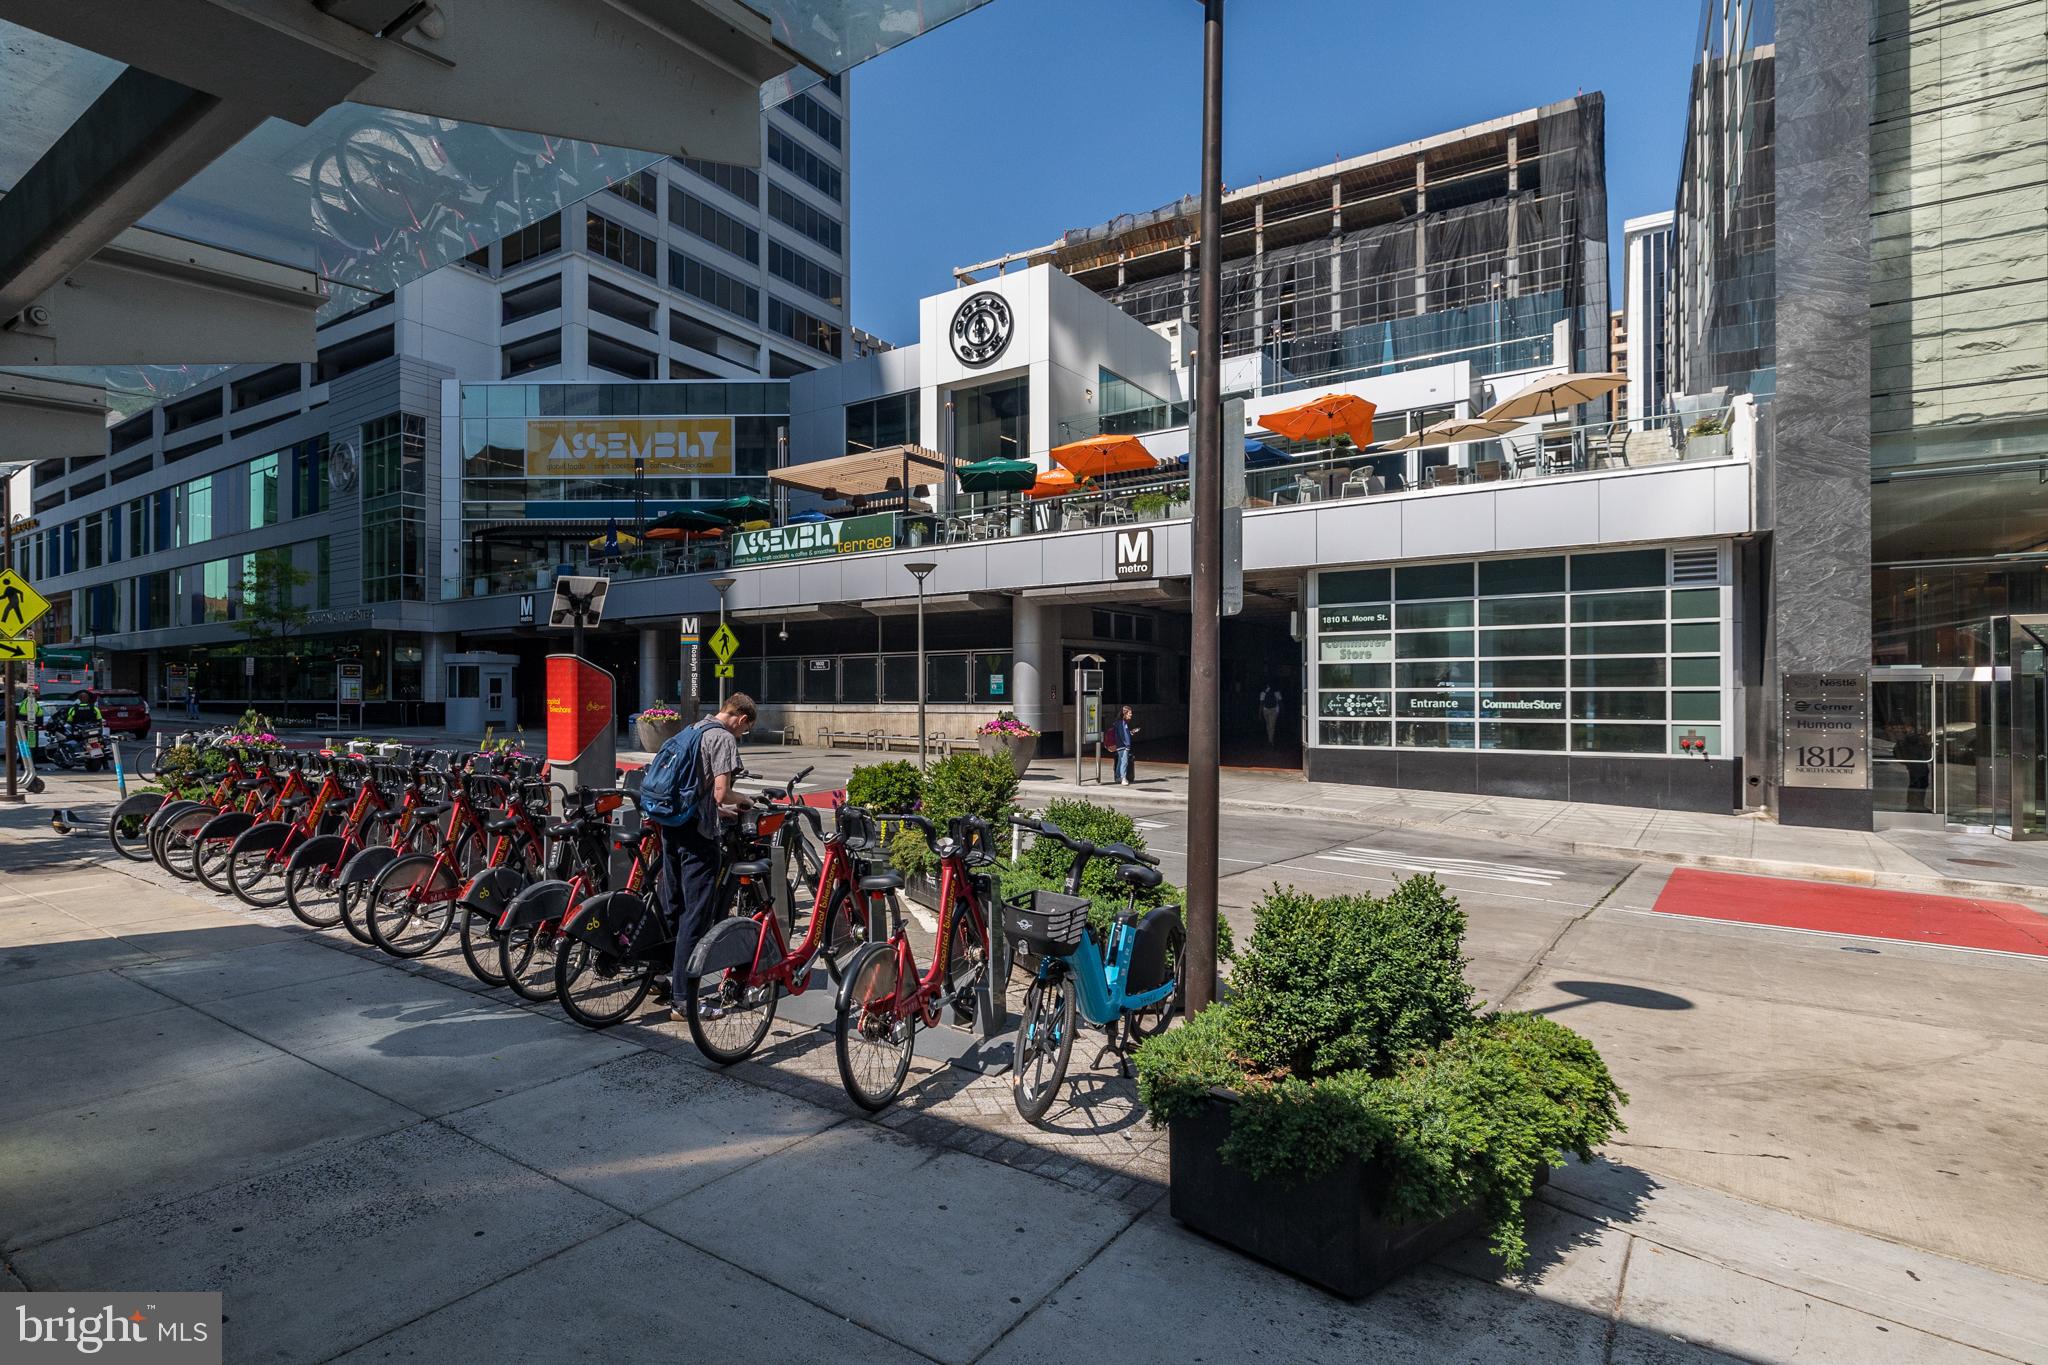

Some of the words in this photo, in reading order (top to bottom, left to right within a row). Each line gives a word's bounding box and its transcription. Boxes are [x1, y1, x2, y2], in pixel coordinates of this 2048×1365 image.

[548, 431, 720, 458] ASSEMBLY
[734, 521, 844, 557] ASSEMBLY
[837, 536, 892, 554] terrace
[1118, 531, 1148, 563] M
[1118, 563, 1148, 574] metro
[520, 596, 533, 616] M
[682, 617, 698, 634] M
[1322, 616, 1341, 624] 1810
[1342, 615, 1350, 623] N.
[1352, 614, 1375, 622] Moore
[1377, 613, 1388, 621] St.
[689, 644, 698, 672] Rosslyn
[1339, 648, 1373, 660] Store
[1410, 699, 1459, 708] Entrance
[1482, 699, 1562, 710] CommuterStore
[1814, 703, 1854, 711] Cerner
[1797, 720, 1852, 729] Humana
[1795, 746, 1856, 768] 1812
[813, 910, 825, 946] capital
[820, 863, 837, 908] bikeshare
[943, 880, 956, 929] bikeshare
[586, 916, 600, 931] cb
[939, 930, 950, 970] capital
